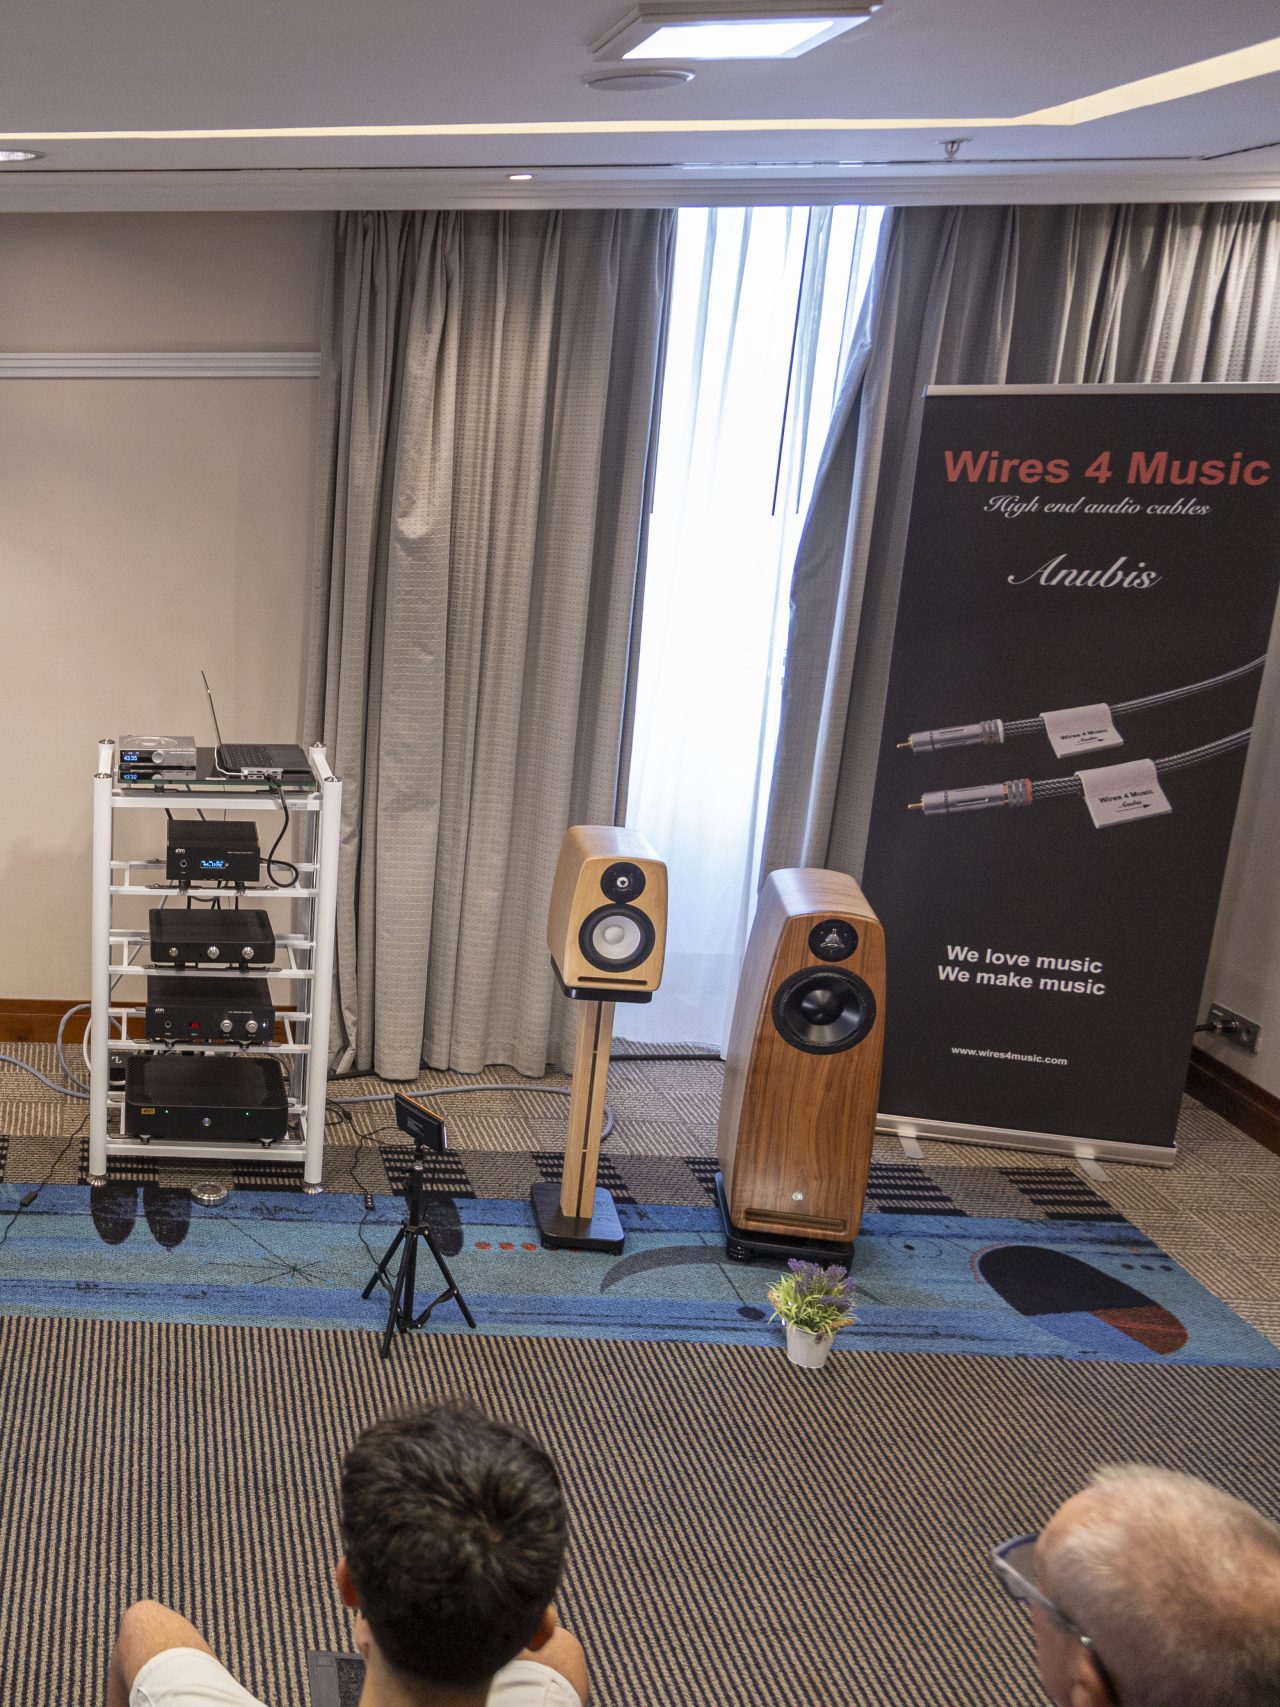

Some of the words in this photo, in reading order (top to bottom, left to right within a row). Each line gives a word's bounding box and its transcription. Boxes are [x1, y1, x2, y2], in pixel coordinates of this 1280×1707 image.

[944, 450, 1070, 484] Wires
[1084, 451, 1112, 484] 4
[1127, 451, 1271, 486] Music
[983, 494, 1041, 519] High
[1043, 495, 1084, 514] end
[1083, 497, 1142, 515] audio
[1146, 498, 1210, 516] cables
[1007, 553, 1163, 590] Anubis
[1098, 795, 1122, 804] Wires
[946, 944, 979, 962] We
[985, 948, 1030, 967] love
[1036, 955, 1103, 974] music
[937, 965, 970, 983] We
[976, 968, 1033, 989] make
[1039, 976, 1107, 996] music
[951, 1046, 1068, 1066] www.wires4music.com
